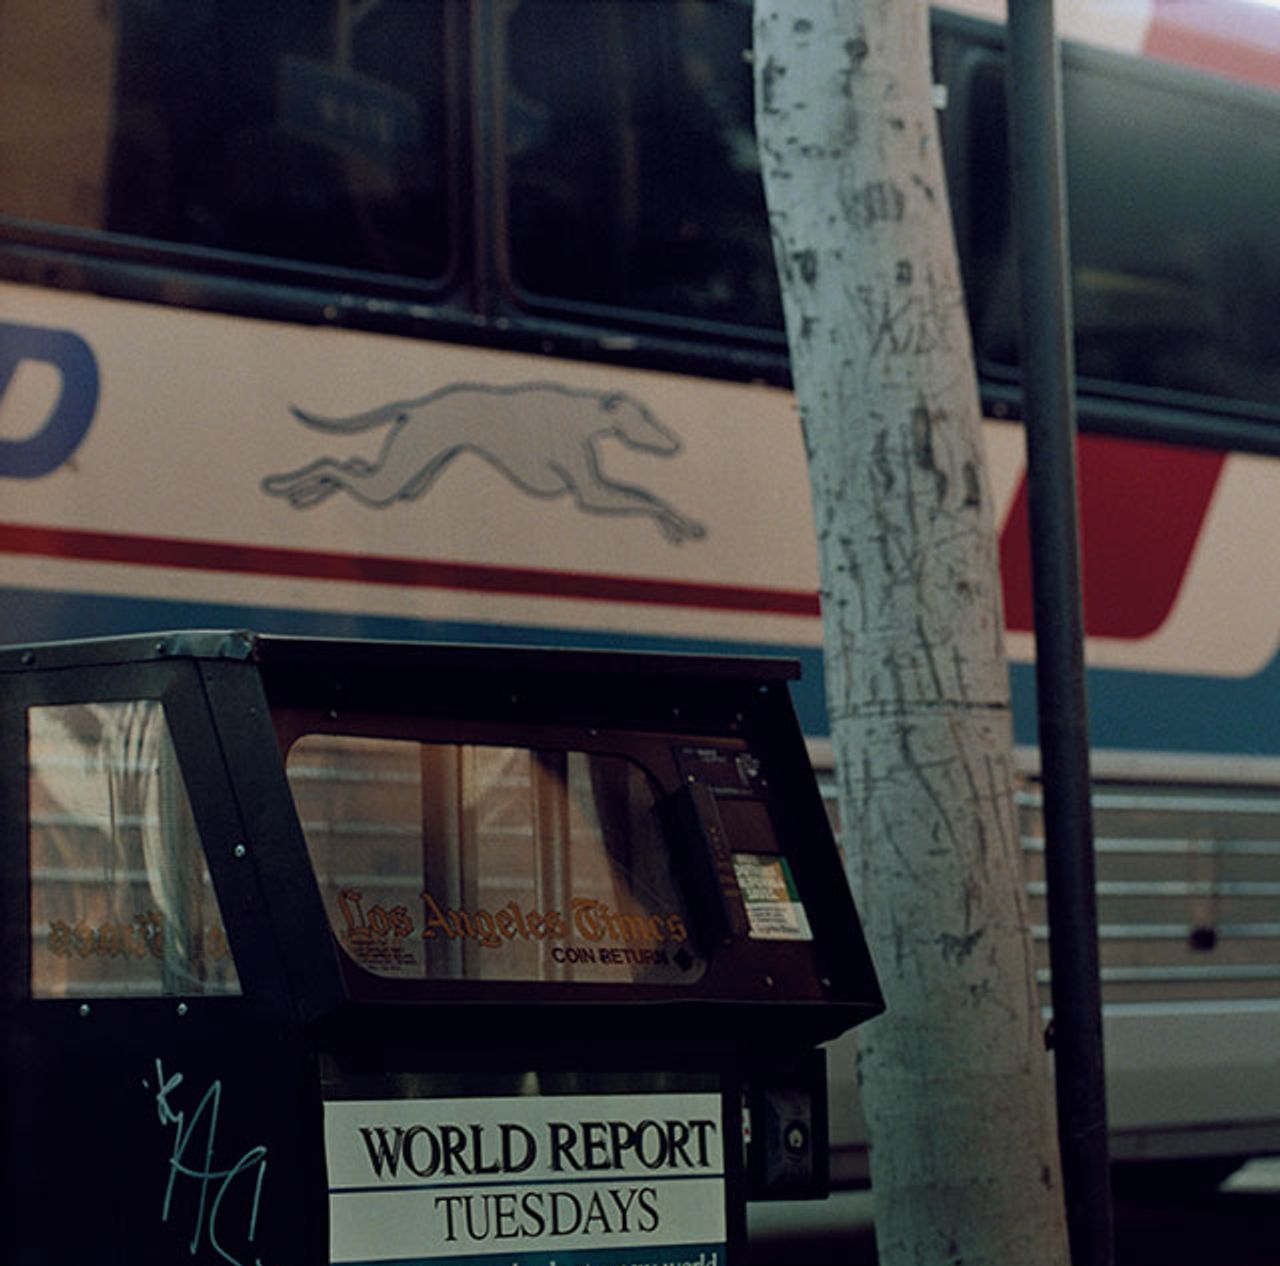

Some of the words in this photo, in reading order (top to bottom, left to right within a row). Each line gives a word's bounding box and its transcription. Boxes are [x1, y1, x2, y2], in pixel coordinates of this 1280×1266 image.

[337, 889, 415, 942] Los
[420, 890, 568, 949] Angeles
[571, 896, 688, 948] Times
[551, 948, 596, 965] COIN
[599, 948, 668, 967] RETURN
[360, 1123, 536, 1178] WORLD
[547, 1119, 717, 1172] REPORT
[434, 1188, 661, 1242] TUESDAYS
